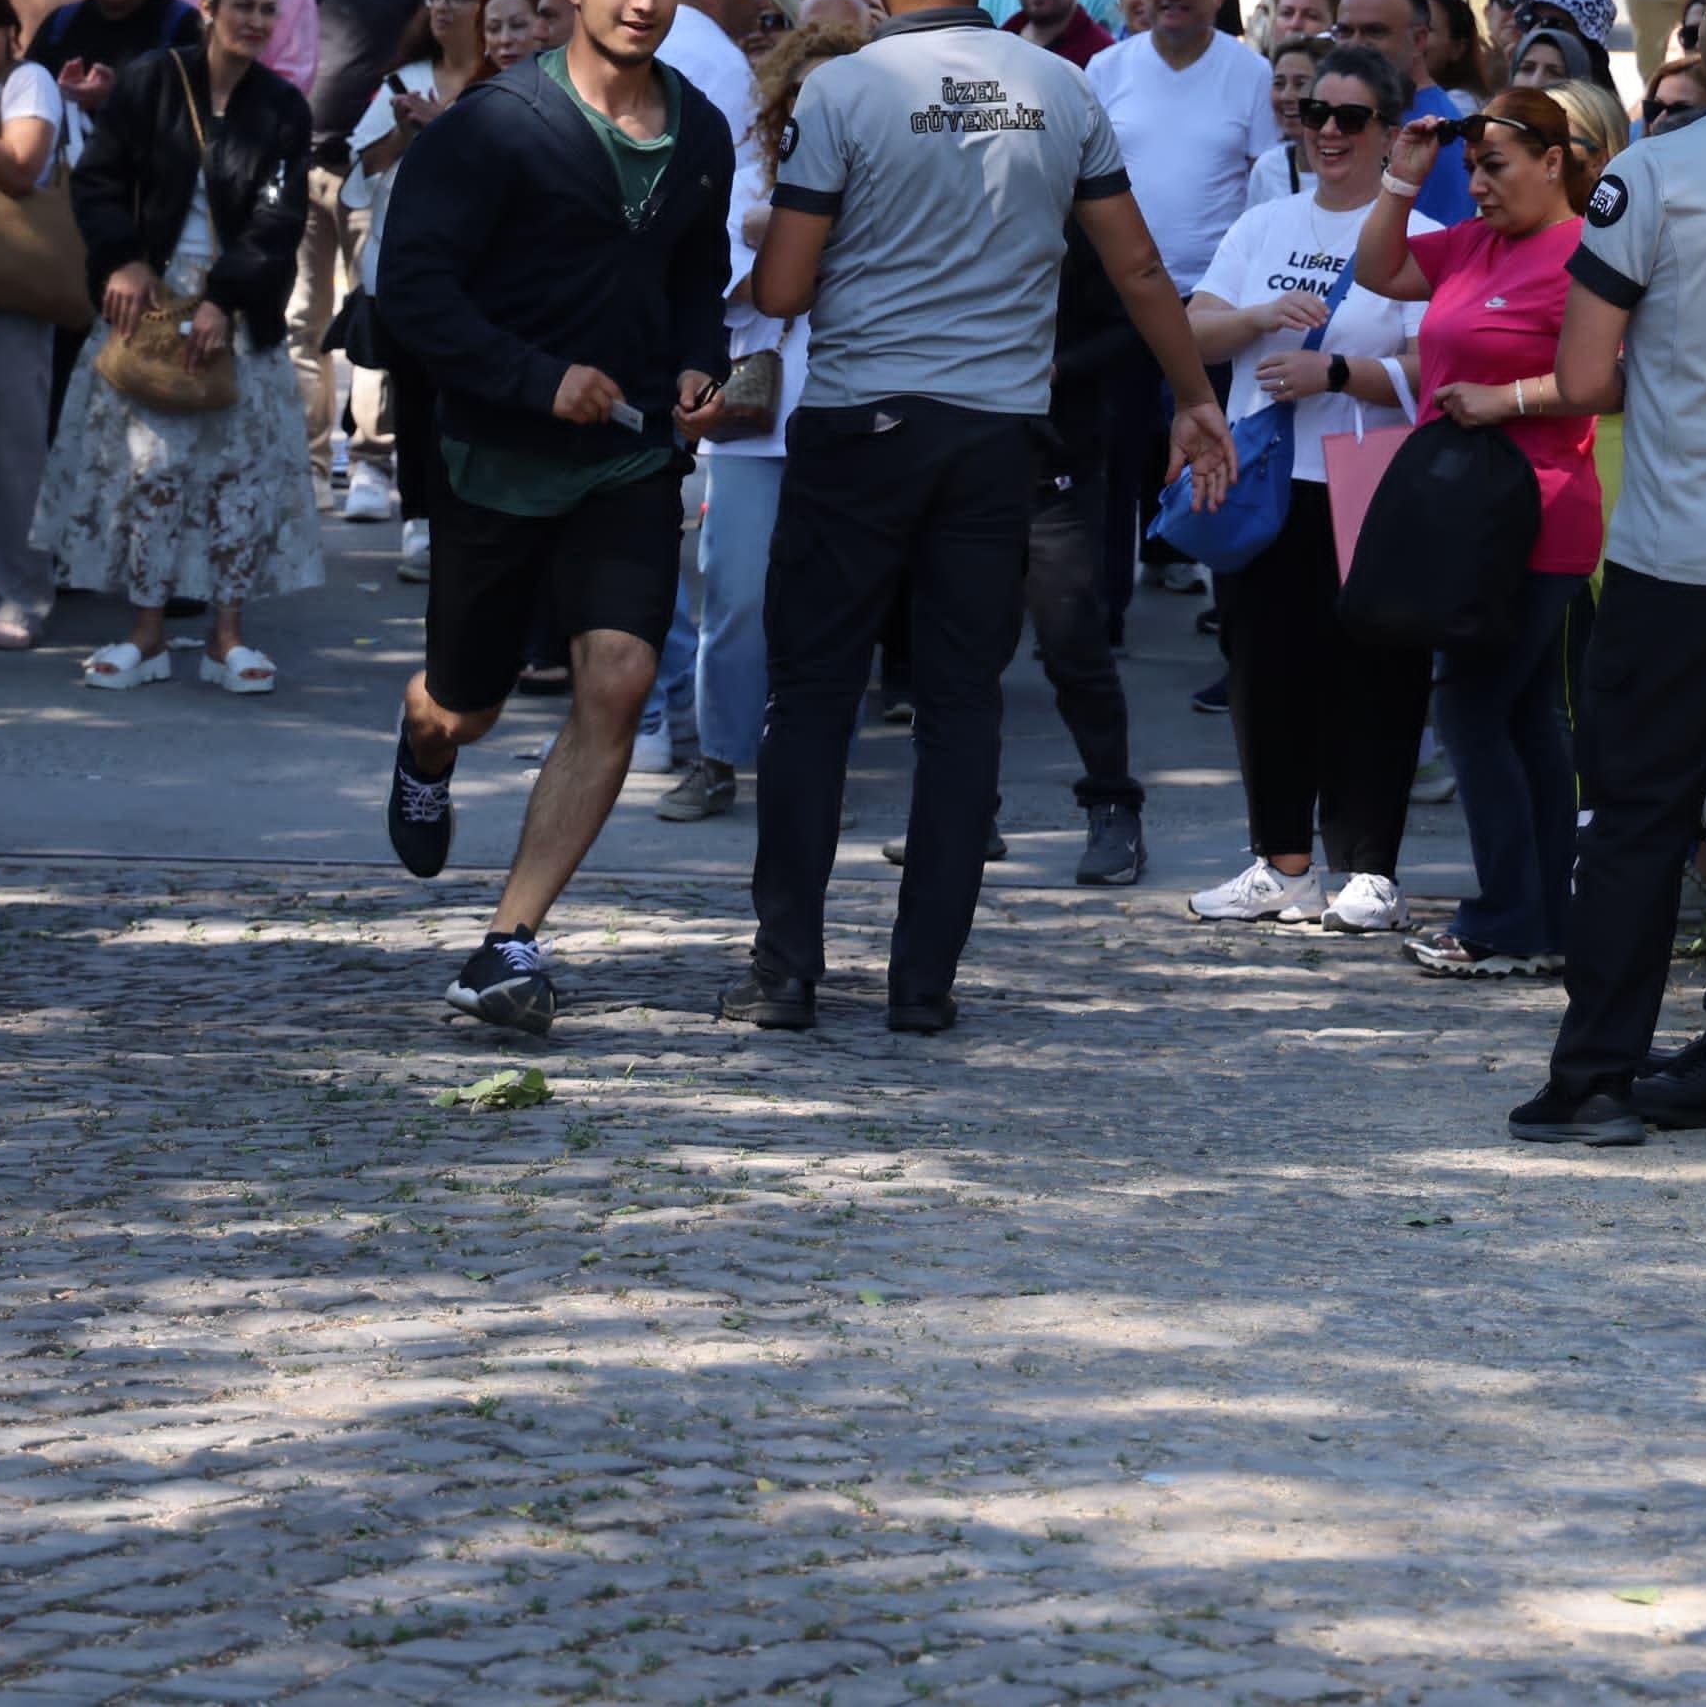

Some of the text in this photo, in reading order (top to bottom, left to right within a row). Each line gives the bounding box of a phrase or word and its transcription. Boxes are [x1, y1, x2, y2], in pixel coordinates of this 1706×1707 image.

[941, 76, 1007, 104] ÖZEL
[910, 102, 1046, 134] GÜVENLİK
[1287, 252, 1346, 274] LIBRE
